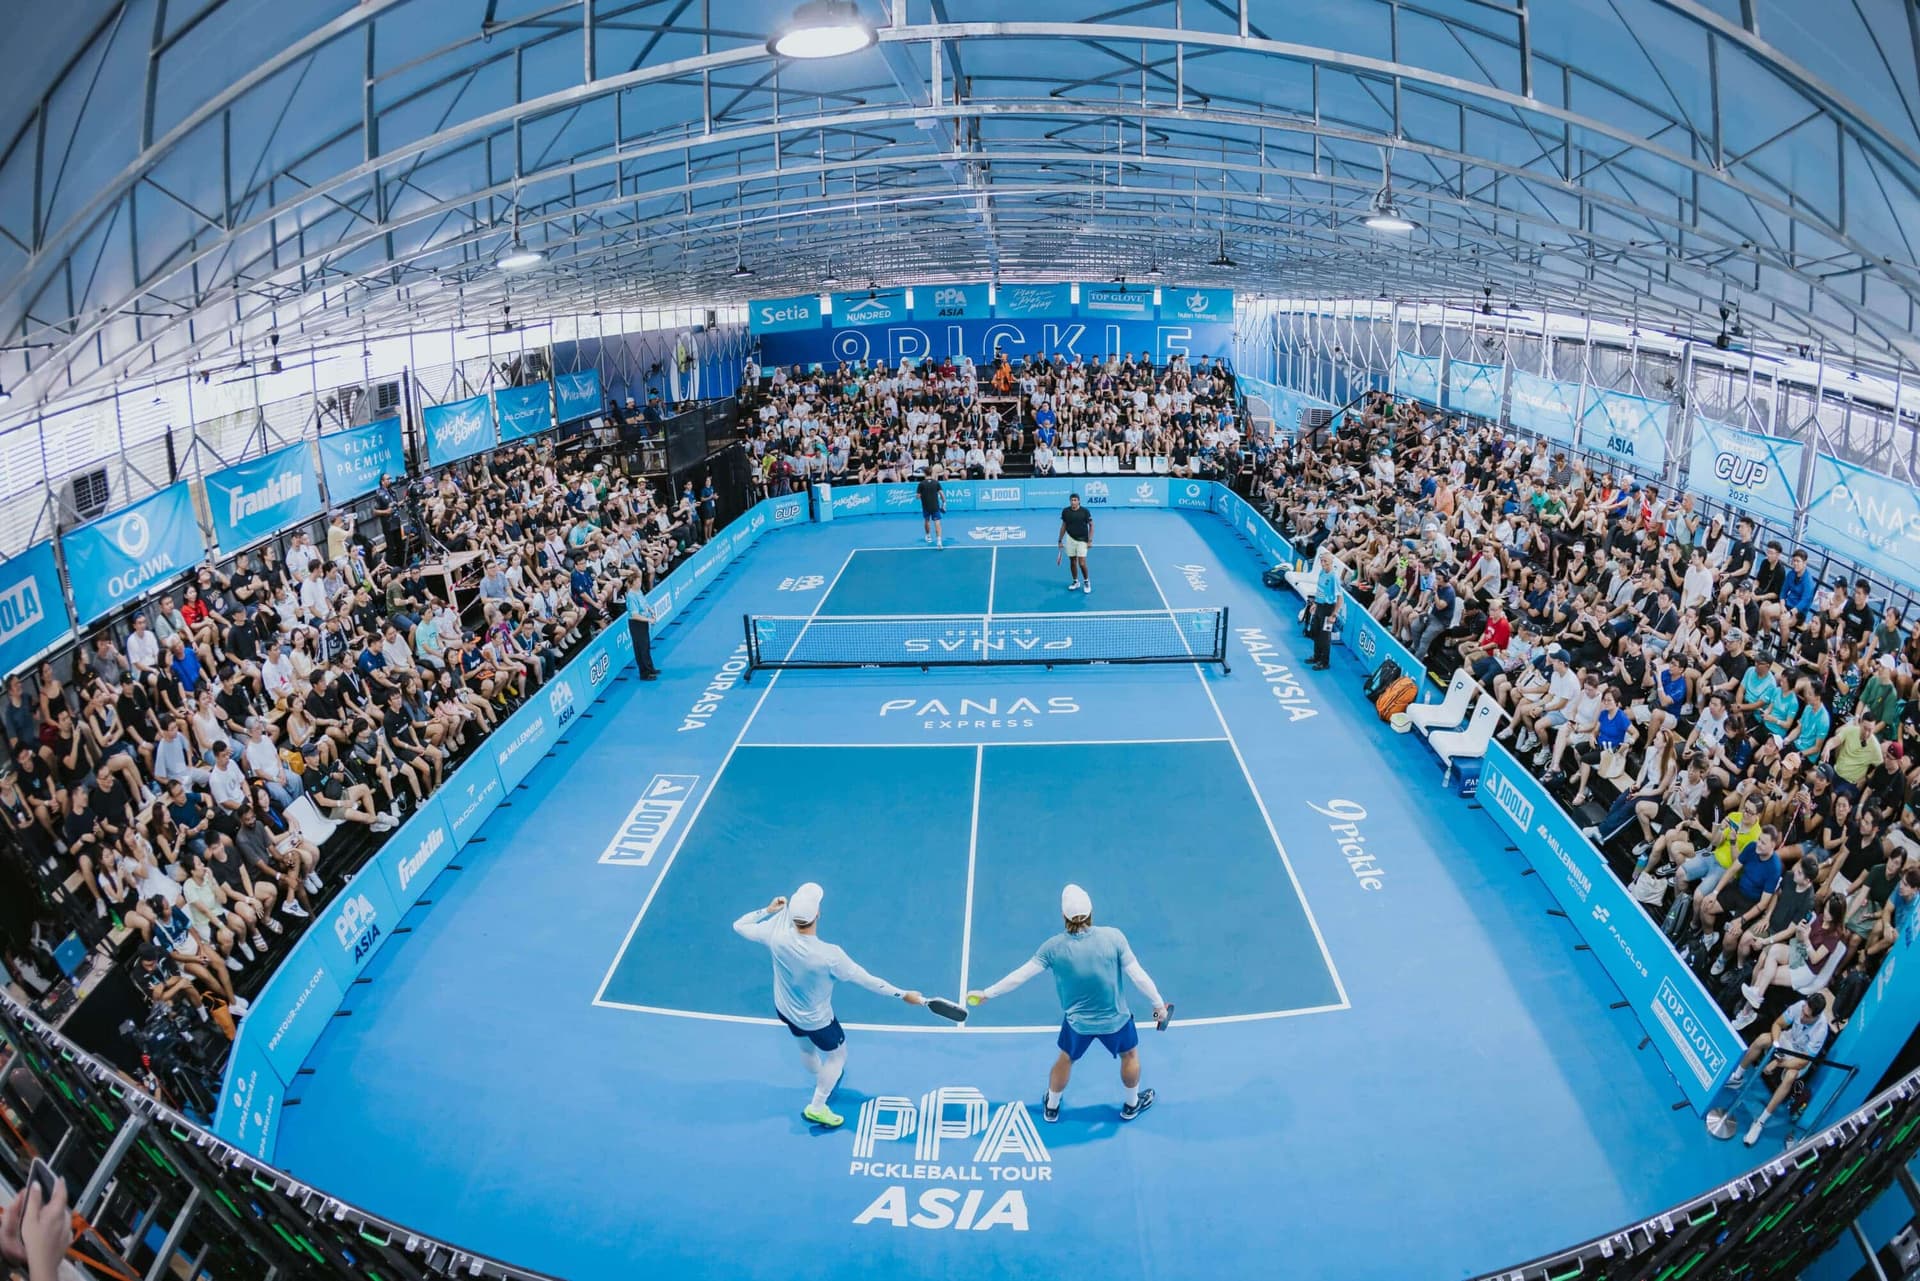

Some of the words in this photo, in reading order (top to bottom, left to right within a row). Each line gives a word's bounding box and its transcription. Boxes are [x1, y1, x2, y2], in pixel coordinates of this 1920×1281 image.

[935, 288, 967, 304] PPA
[1090, 293, 1110, 301] TOP
[1111, 293, 1143, 302] GLOVE
[761, 305, 809, 325] Setia
[938, 308, 964, 317] ASIA
[344, 434, 384, 456] PLAZA
[1607, 435, 1634, 456] ASIA
[337, 447, 391, 477] PREMIUM
[1715, 452, 1768, 489] CUP
[230, 471, 302, 528] Franklin
[1085, 481, 1109, 496] PPA
[1728, 489, 1749, 504] 2025
[775, 504, 801, 520] CUP
[108, 553, 174, 598] OGAWA
[904, 636, 1073, 652] PANAS
[1359, 631, 1376, 656] CUP
[591, 653, 609, 686] CUP
[1235, 628, 1318, 722] MALAYSIA
[549, 681, 575, 714] PPA
[879, 697, 1080, 717] PANAS
[559, 705, 575, 728] ASIA
[924, 719, 1033, 729] EXPRESS
[1500, 783, 1530, 828] JOOLA
[607, 802, 673, 860] JOOLA
[398, 827, 444, 891] Franklin
[1547, 835, 1592, 893] MILLENNIUM
[1566, 874, 1587, 903] MOTORS
[335, 893, 375, 948] PPA
[355, 923, 381, 965] ASIA
[1608, 925, 1648, 978] PACOLOS
[268, 967, 325, 1051] PPATOUR-ASIA.COM
[1661, 984, 1684, 1017] TOP
[1682, 1017, 1721, 1073] GLOVE
[852, 1086, 1051, 1163] PPA
[850, 1161, 982, 1181] PICKLEBALL
[988, 1166, 1053, 1181] TOUR
[851, 1186, 1029, 1231] ASIA
